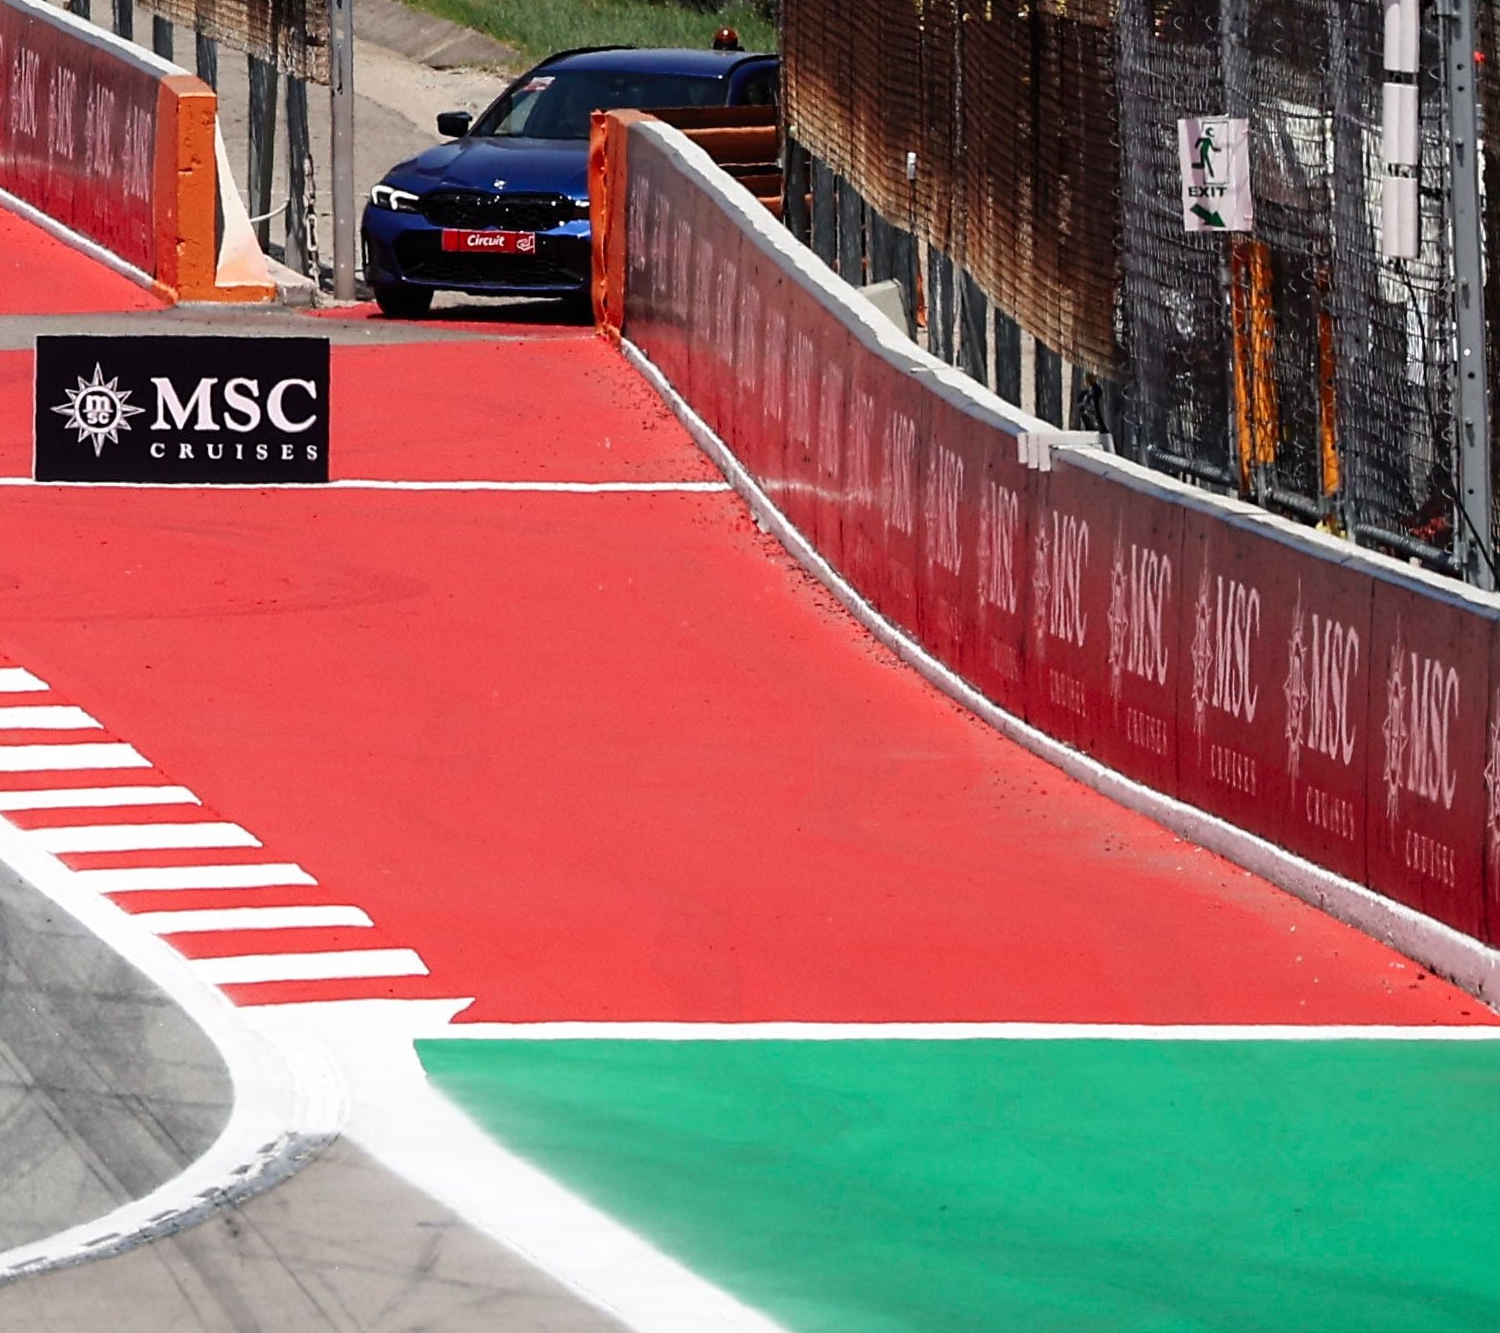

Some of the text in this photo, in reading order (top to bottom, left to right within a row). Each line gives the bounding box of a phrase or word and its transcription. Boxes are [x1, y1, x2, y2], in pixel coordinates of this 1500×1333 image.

[466, 234, 506, 247] Circuit
[1187, 186, 1228, 198] EXIT
[149, 376, 318, 433] MSC
[150, 441, 319, 461] CRUISES
[1050, 509, 1090, 649] MSC
[1128, 543, 1172, 686] MSC
[1213, 575, 1261, 723] MSC
[1307, 613, 1360, 766] MSC
[1407, 651, 1461, 811] MSC
